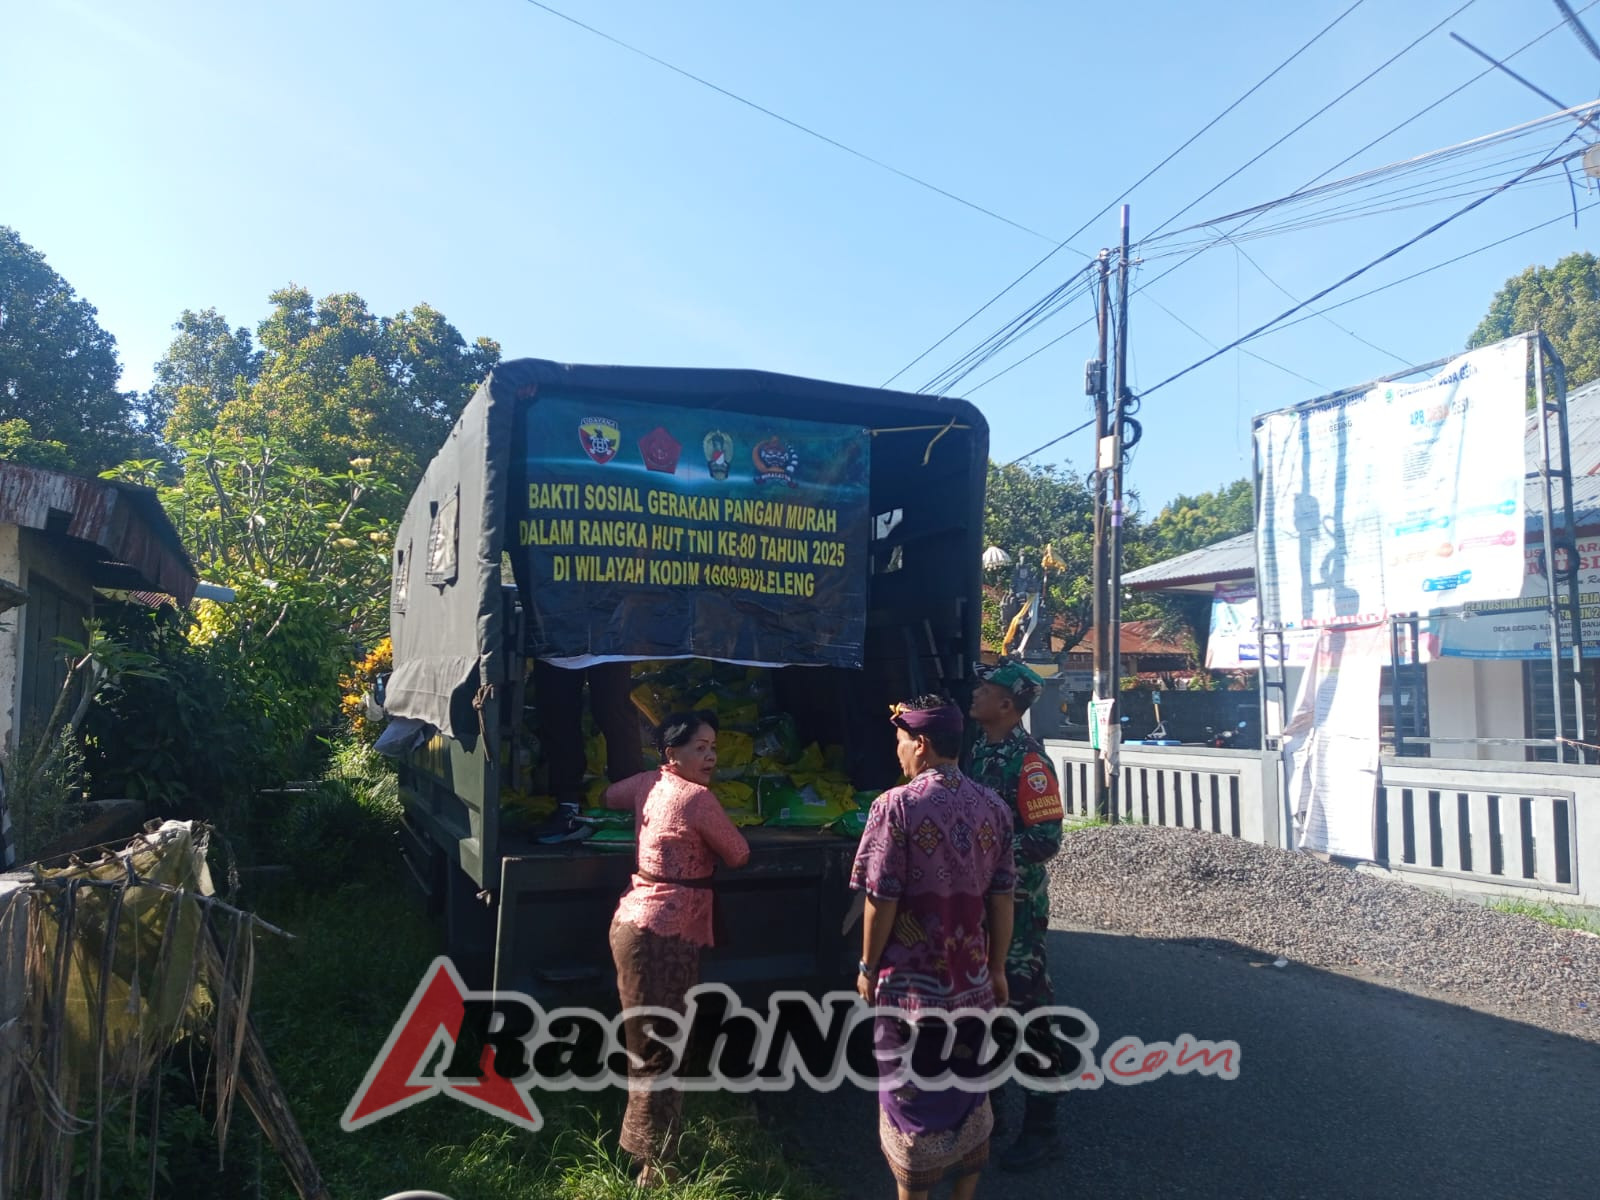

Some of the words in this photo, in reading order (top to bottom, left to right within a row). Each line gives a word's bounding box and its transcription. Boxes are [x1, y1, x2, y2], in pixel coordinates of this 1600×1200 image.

[529, 483, 579, 510] BAKTI
[584, 484, 644, 513] SOSIAL
[648, 489, 720, 521] GERAKAN
[724, 499, 783, 527] PANGAN
[785, 505, 837, 533] MURAH
[519, 519, 574, 546] DALAM
[579, 520, 648, 549] RANGKA
[652, 524, 684, 552] HUT
[687, 529, 713, 554] TNI
[718, 530, 757, 559] KE-80
[760, 535, 808, 563] TAHUN
[812, 540, 846, 567] 2025
[553, 555, 570, 582] DI
[575, 556, 645, 585] WILAYAH
[650, 559, 700, 586] KODIM
[703, 563, 816, 598] 1609/BULELENG
